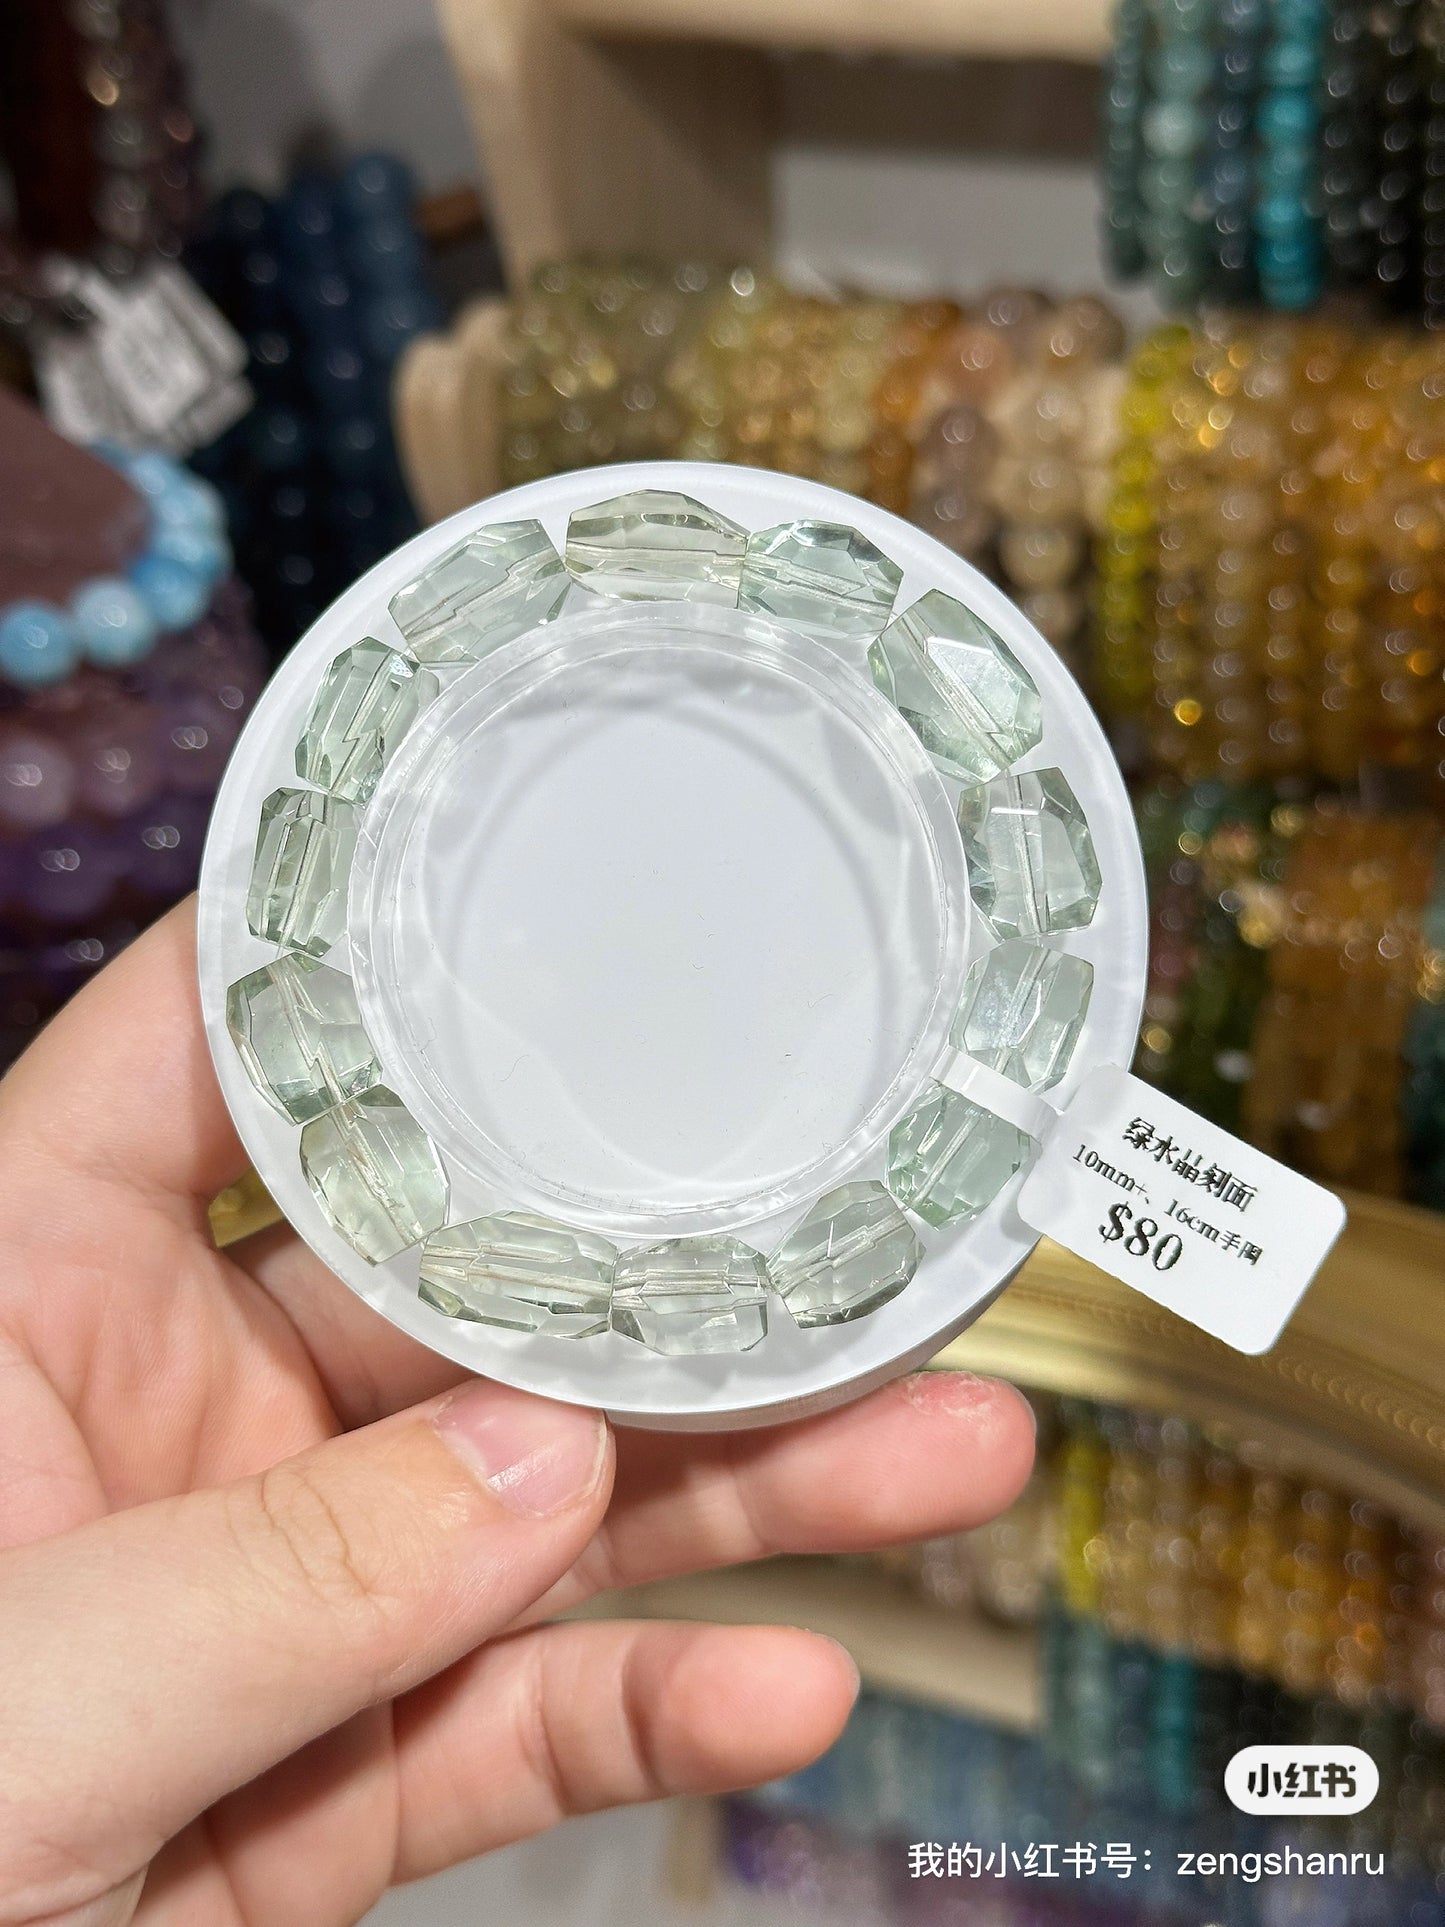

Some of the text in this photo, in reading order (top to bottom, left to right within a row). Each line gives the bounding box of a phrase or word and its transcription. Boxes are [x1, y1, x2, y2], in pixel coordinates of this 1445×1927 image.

[1122, 1116, 1258, 1212] 绿水晶刻面
[1098, 1201, 1183, 1271] $80
